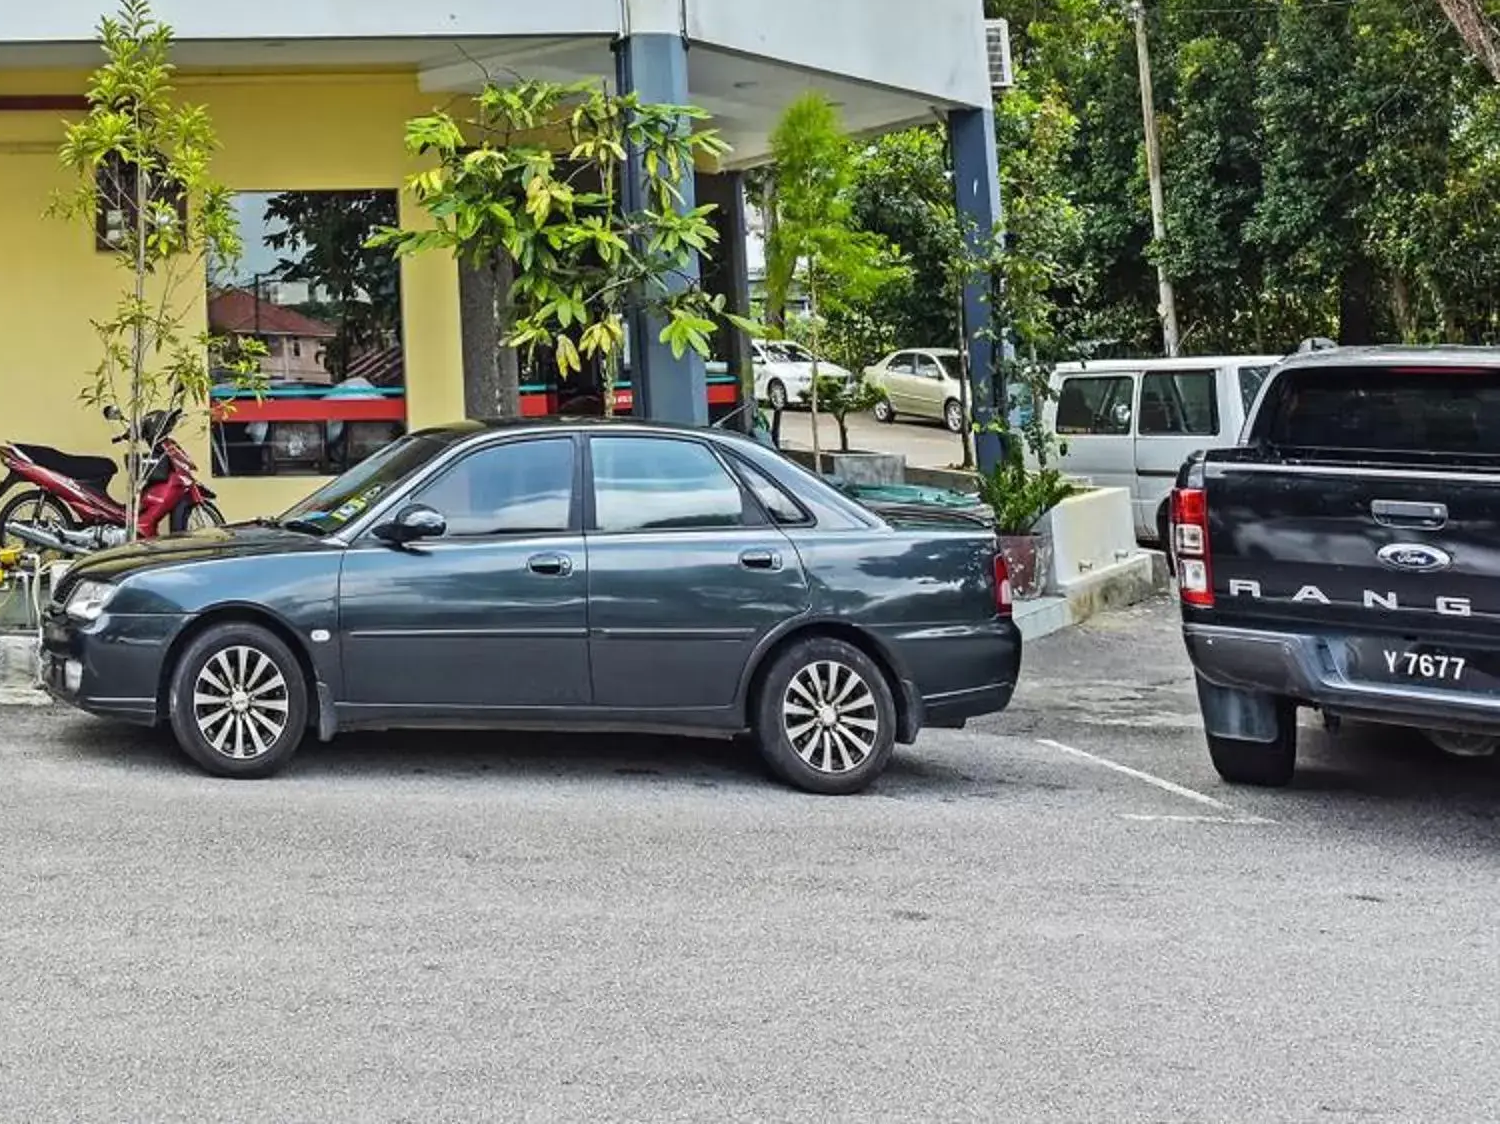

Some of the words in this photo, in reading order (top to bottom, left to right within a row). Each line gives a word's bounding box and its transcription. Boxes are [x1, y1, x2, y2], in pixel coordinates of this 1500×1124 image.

[1397, 550, 1427, 565] Ford
[1228, 578, 1472, 617] RANG
[1383, 649, 1397, 673] Y
[1403, 651, 1465, 680] 7677
